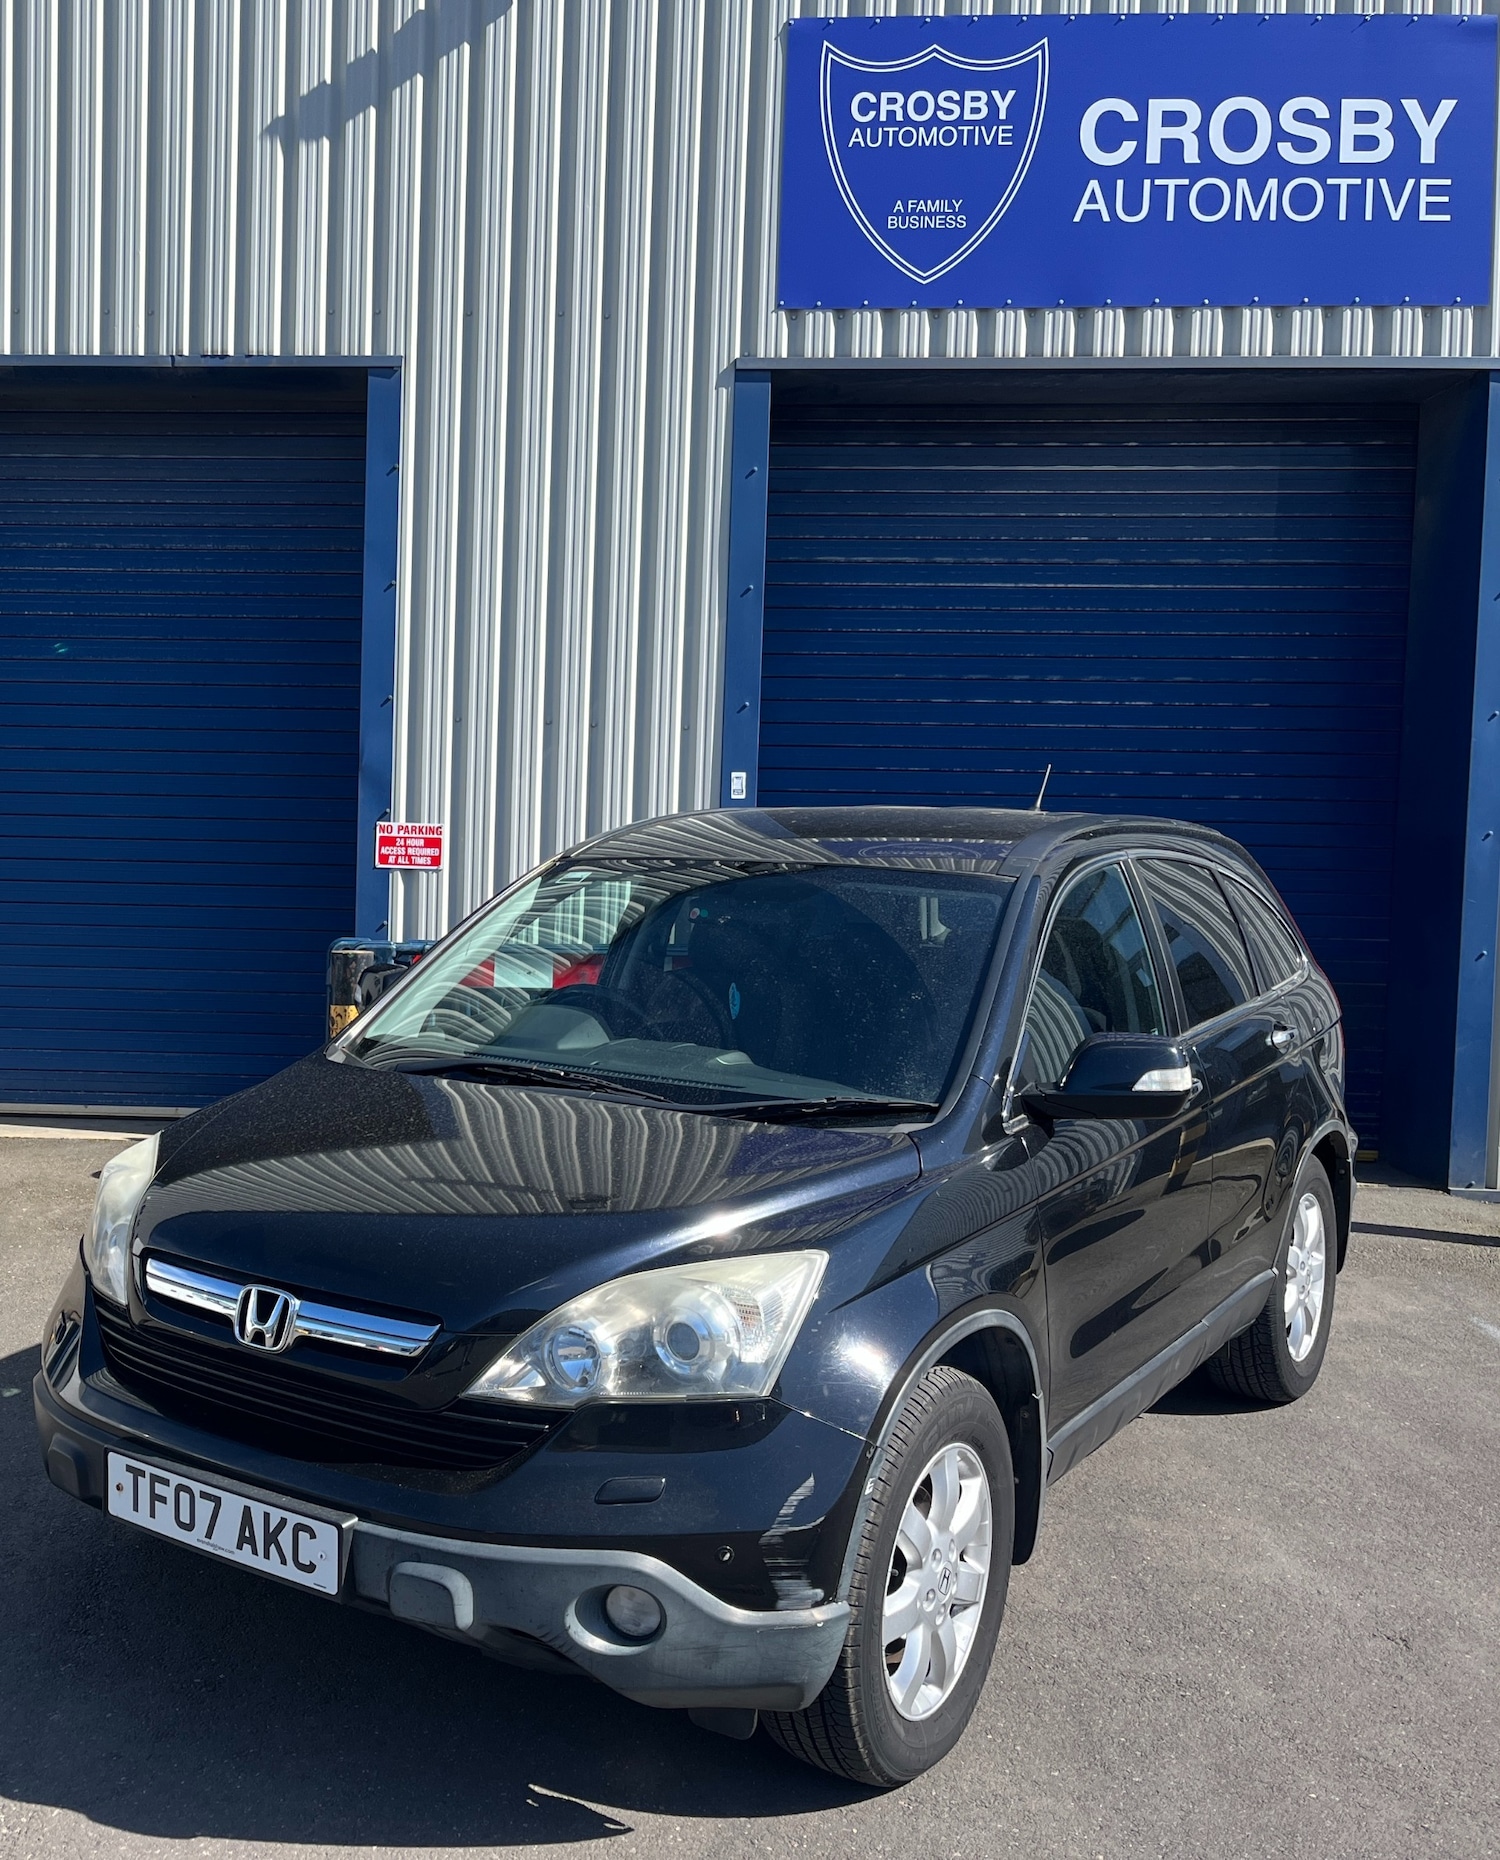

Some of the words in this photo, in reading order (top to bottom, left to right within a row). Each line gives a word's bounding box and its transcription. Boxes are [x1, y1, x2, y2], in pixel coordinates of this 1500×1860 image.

[850, 89, 1017, 123] CROSBY
[848, 125, 1014, 148] AUTOMOTIVE
[1079, 96, 1459, 167] CROSBY
[893, 199, 905, 213] A
[907, 199, 963, 213] FAMILY
[1073, 177, 1452, 224] AUTOMOTIVE
[887, 215, 967, 229] BUSINESS
[378, 824, 393, 835] NO
[397, 825, 443, 836] PARKING
[395, 838, 405, 847] 24
[406, 838, 425, 847] HOUR
[380, 846, 406, 855] ACCESS
[407, 847, 440, 857] REQUIRED
[387, 856, 397, 864] AT
[397, 856, 410, 865] ALL
[411, 856, 432, 865] TIMES
[125, 1463, 222, 1540] TF07
[236, 1504, 317, 1574] AKC
